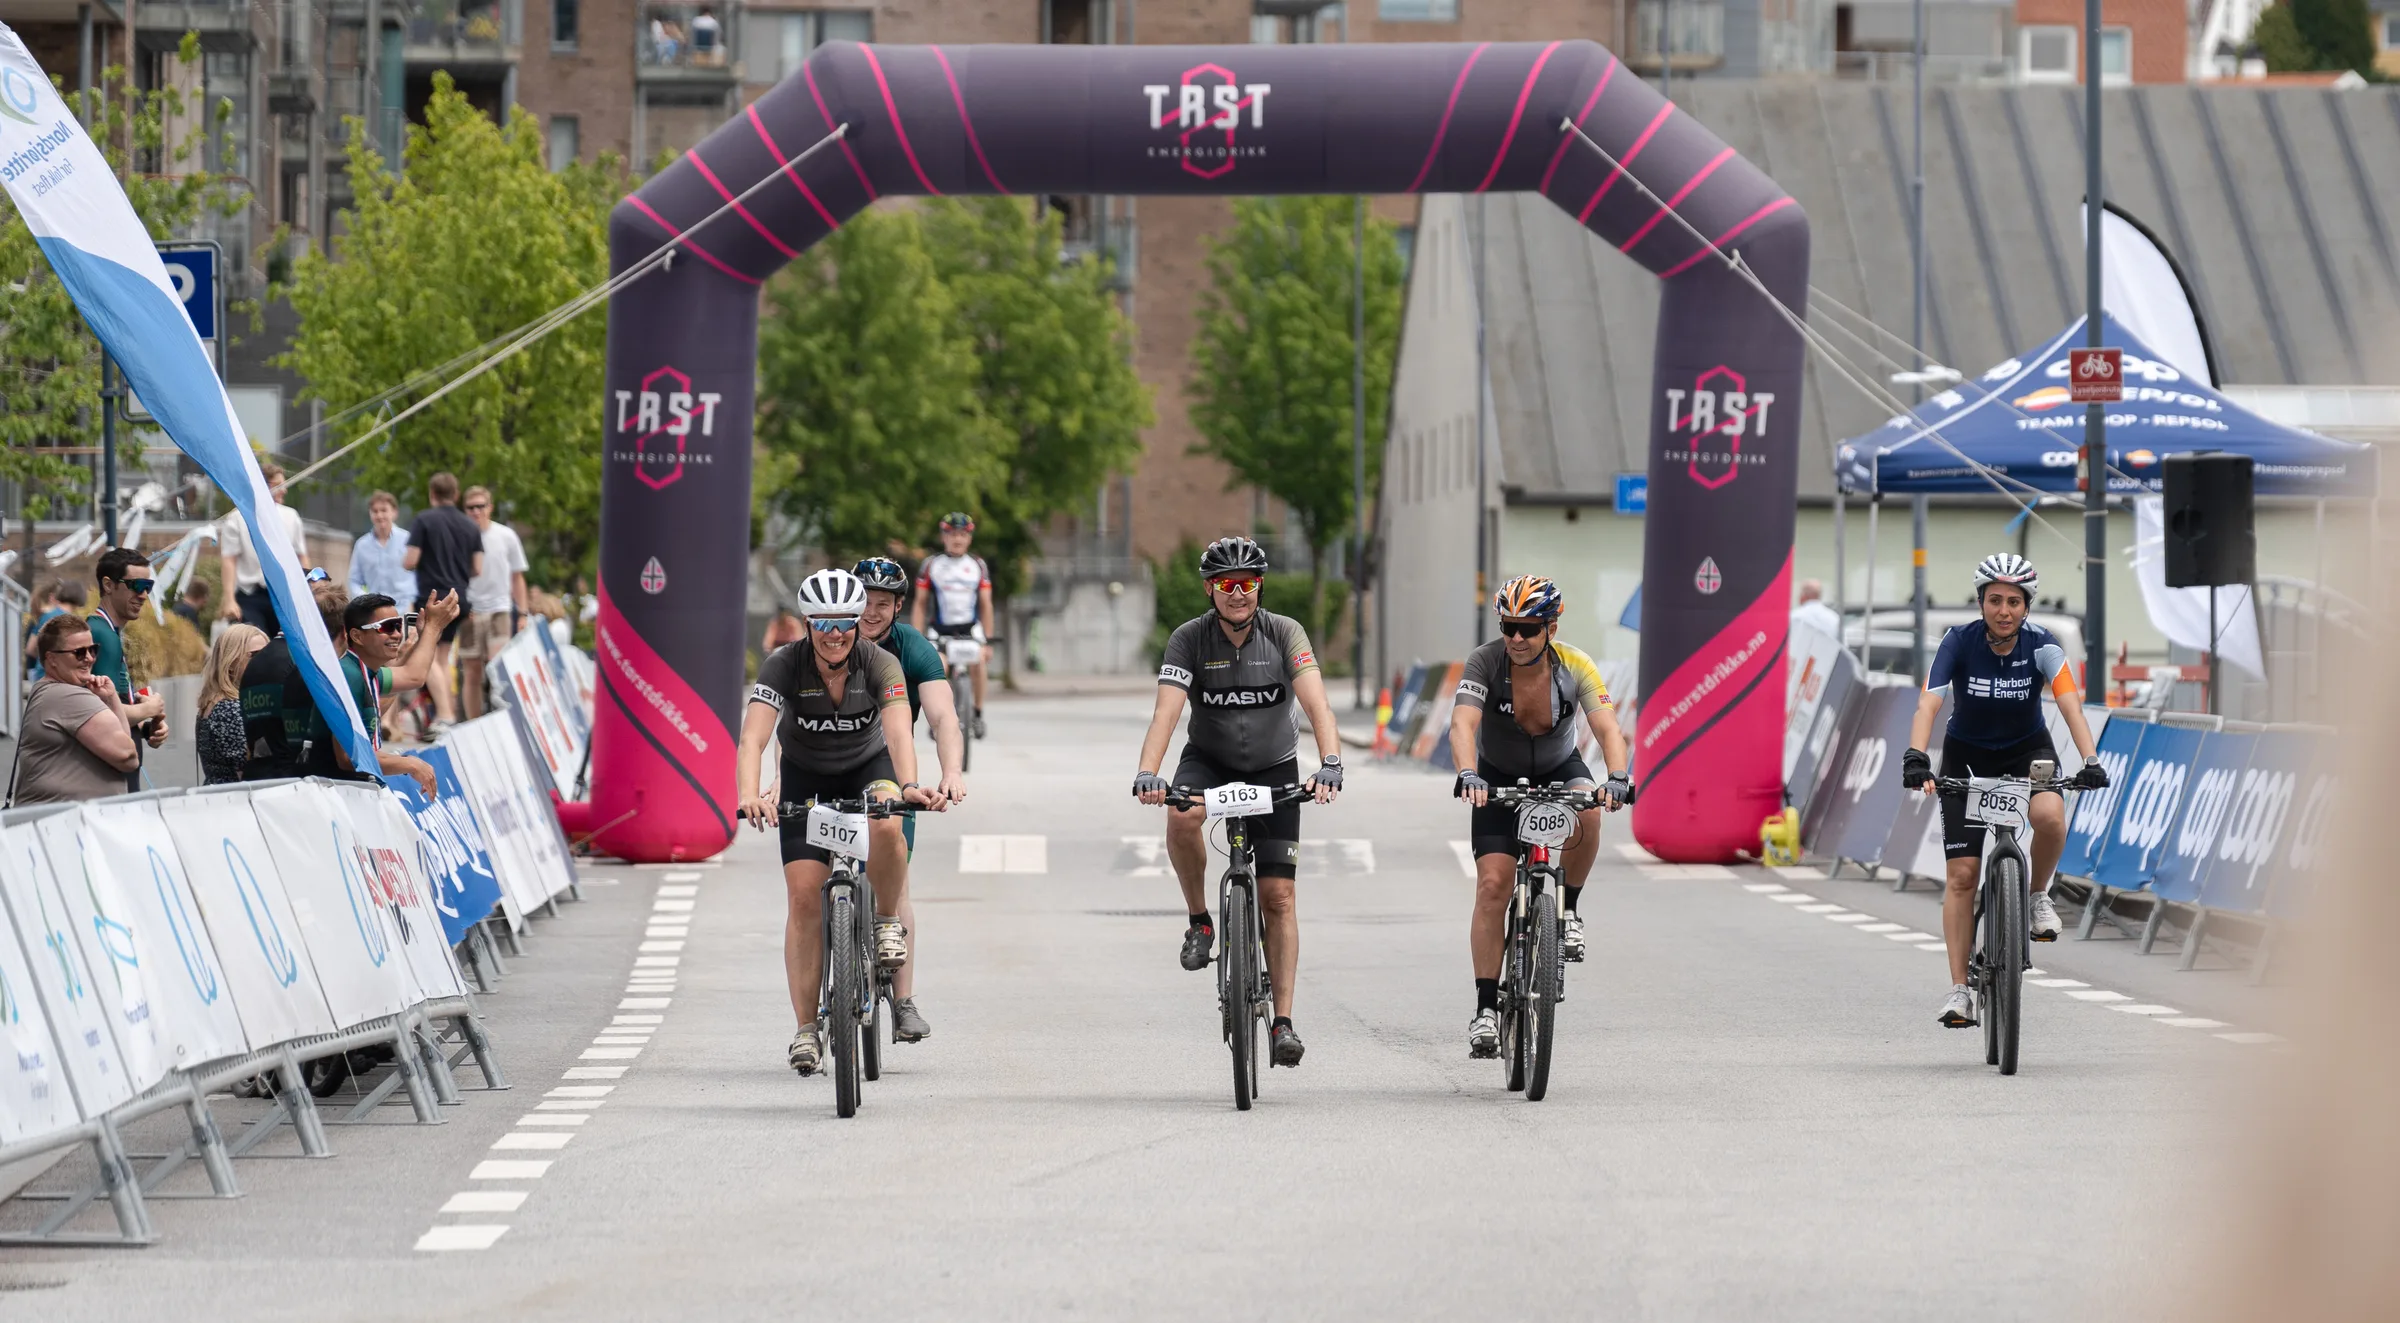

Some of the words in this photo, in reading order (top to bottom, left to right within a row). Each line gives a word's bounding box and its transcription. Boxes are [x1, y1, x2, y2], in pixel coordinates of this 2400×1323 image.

[1146, 146, 1268, 158] ENERGIDRIKK
[2046, 354, 2180, 382] cop
[2123, 386, 2222, 411] EPSOL
[2016, 415, 2074, 430] TEAM
[2078, 414, 2138, 427] COP
[2152, 414, 2229, 431] REPSOL
[613, 451, 713, 464] ENERGIDRIKK
[1664, 449, 1767, 464] ENERGIDRIKK
[600, 624, 708, 753] www.torstdrikke.no
[1643, 630, 1767, 749] www.torstdrikke.no
[1994, 677, 2032, 688] Harbour
[753, 687, 785, 706] ASIV
[1203, 687, 1279, 706] MASIV
[1994, 688, 2030, 700] Energy
[797, 710, 875, 732] MASIV
[1218, 788, 1258, 804] 5163
[1980, 794, 2017, 813] 8052
[1529, 814, 1565, 831] 5085
[2120, 758, 2186, 872] coop
[2178, 767, 2238, 882] coop
[819, 822, 858, 845] 5107
[2219, 767, 2296, 889] coop
[1946, 842, 1968, 850] Santini
